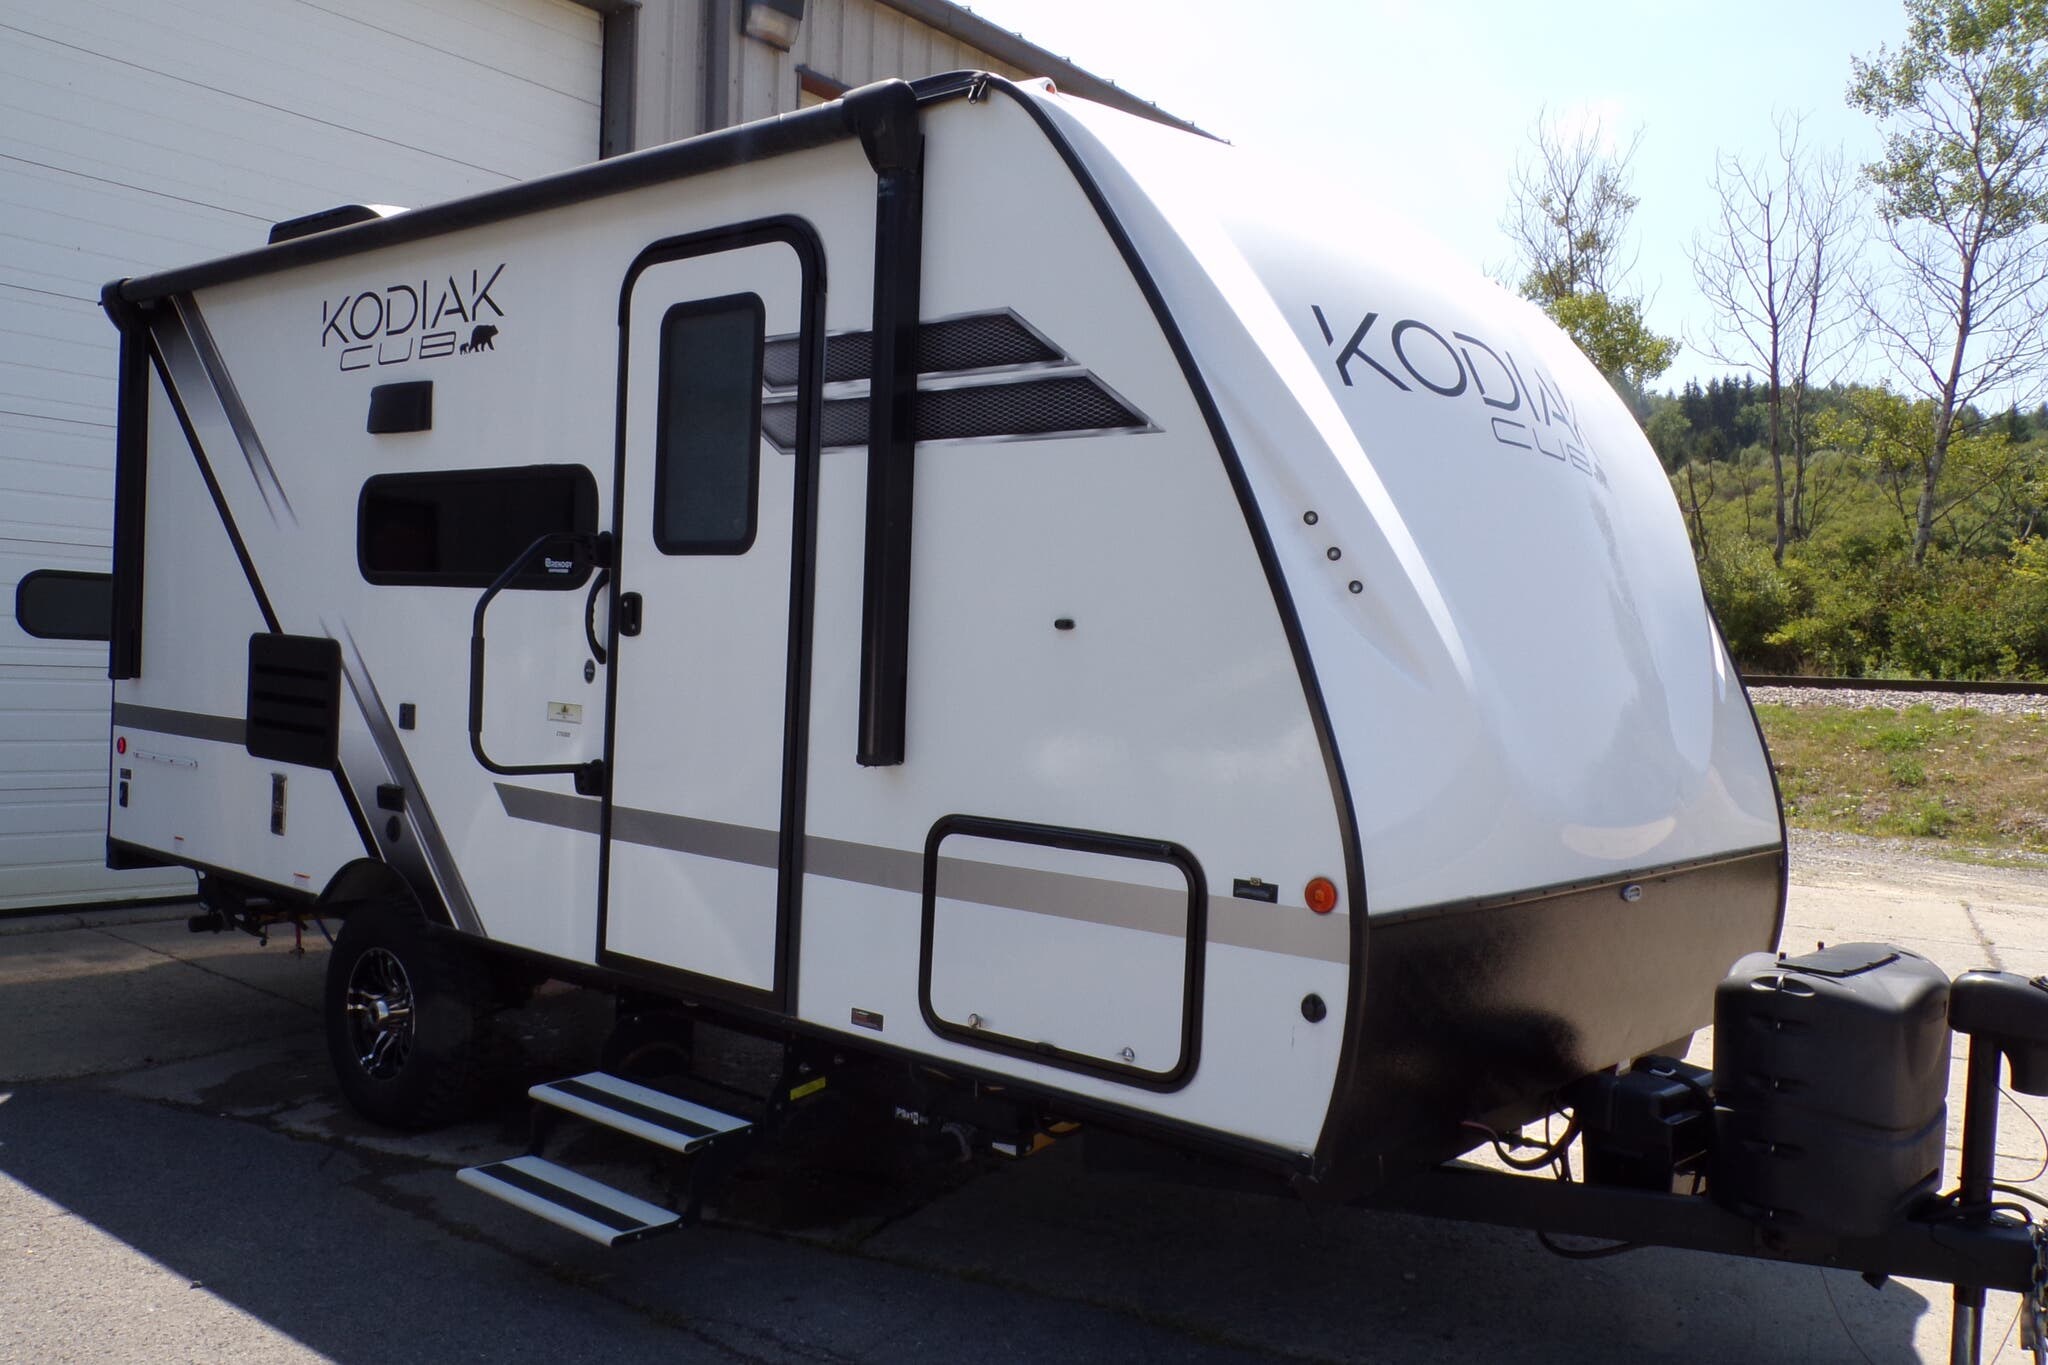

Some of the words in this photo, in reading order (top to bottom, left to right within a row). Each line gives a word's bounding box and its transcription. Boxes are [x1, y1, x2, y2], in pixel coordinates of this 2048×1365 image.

[322, 263, 506, 347] KODIAK
[340, 331, 456, 371] CUB
[1311, 305, 1600, 462] KODIAK
[1491, 416, 1593, 477] CUB
